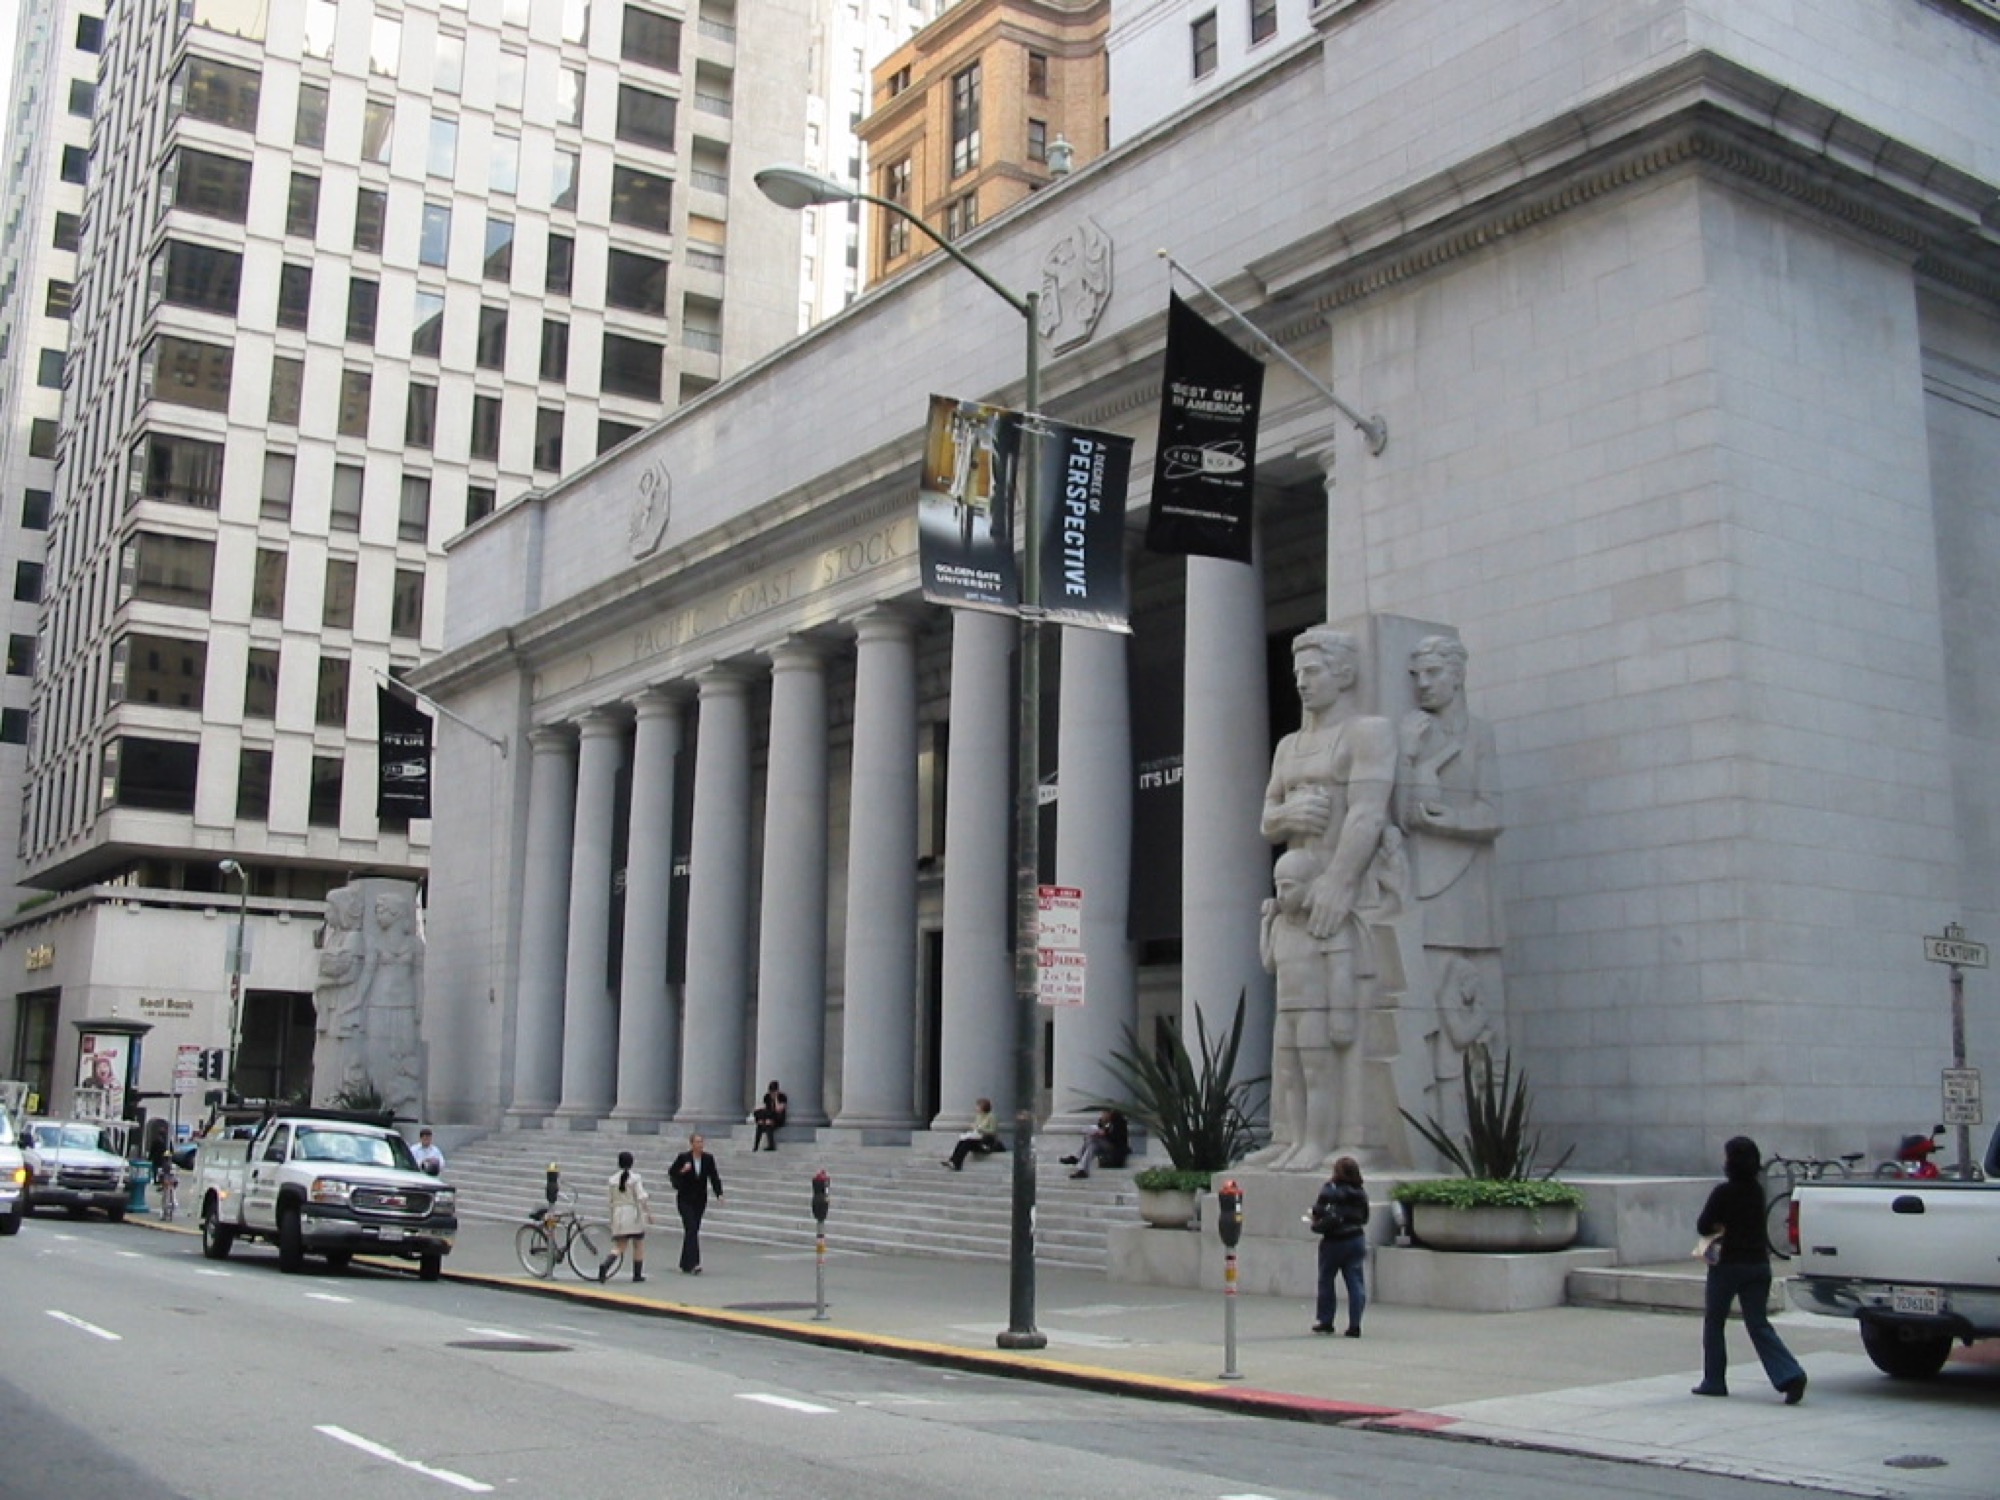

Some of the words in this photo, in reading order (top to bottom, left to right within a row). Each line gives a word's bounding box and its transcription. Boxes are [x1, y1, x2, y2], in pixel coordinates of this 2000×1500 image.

[1213, 391, 1243, 402] GYM
[1096, 442, 1107, 451] A
[1090, 454, 1106, 496] DEGREE
[1089, 497, 1100, 513] OF
[1064, 437, 1093, 599] PERSPECTIVE
[727, 568, 796, 622] COAST
[822, 524, 898, 584] STOCK
[935, 564, 975, 577] GOLDEN
[976, 569, 1001, 581] GATE
[936, 573, 1002, 591] UNIVERSITY
[1140, 771, 1163, 789] IT'S
[1935, 942, 1980, 961] CENTURY
[1054, 955, 1086, 967] PARKING
[167, 998, 193, 1010] Bank
